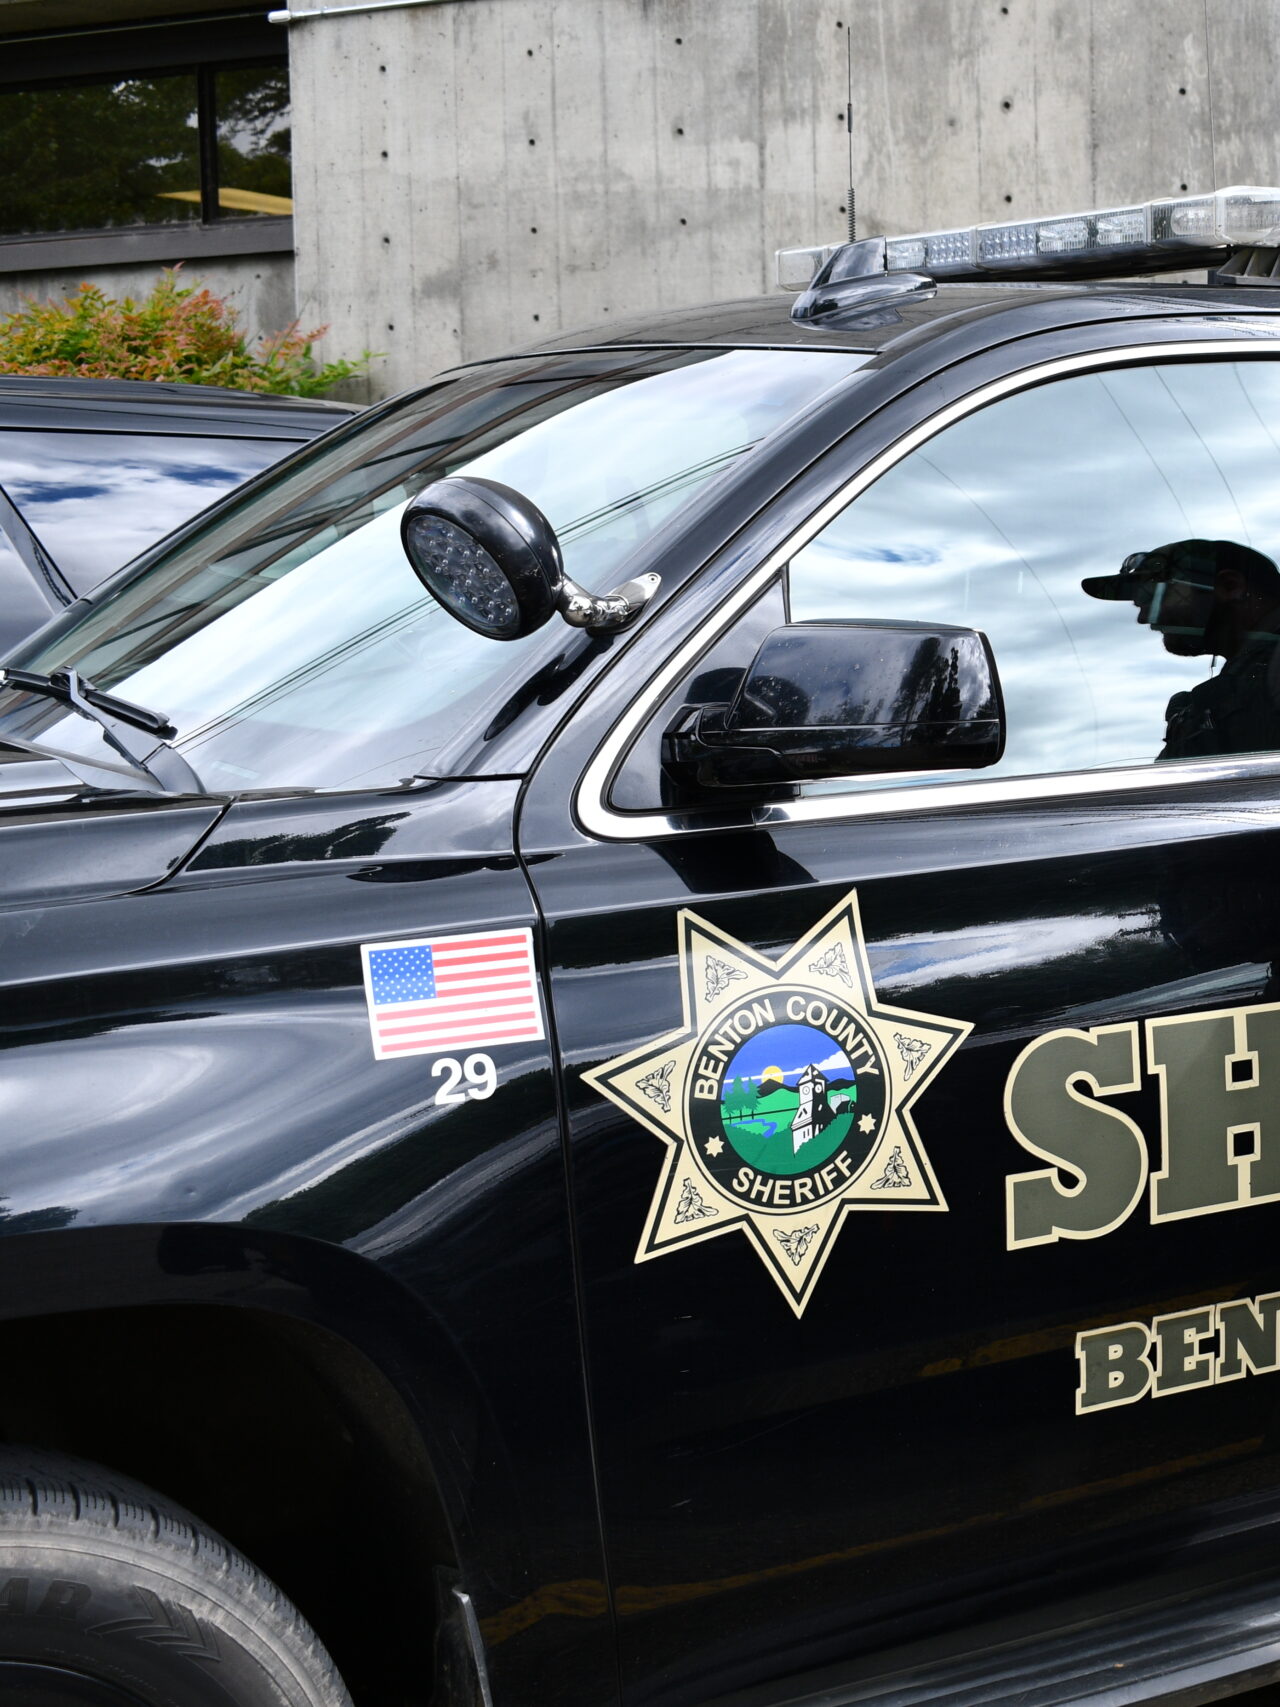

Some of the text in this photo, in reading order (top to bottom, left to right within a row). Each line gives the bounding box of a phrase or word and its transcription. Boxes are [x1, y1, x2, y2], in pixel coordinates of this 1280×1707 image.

[694, 996, 880, 1101] BENTON COUNTY
[431, 1053, 497, 1105] 29
[732, 1150, 852, 1205] SHERIFF
